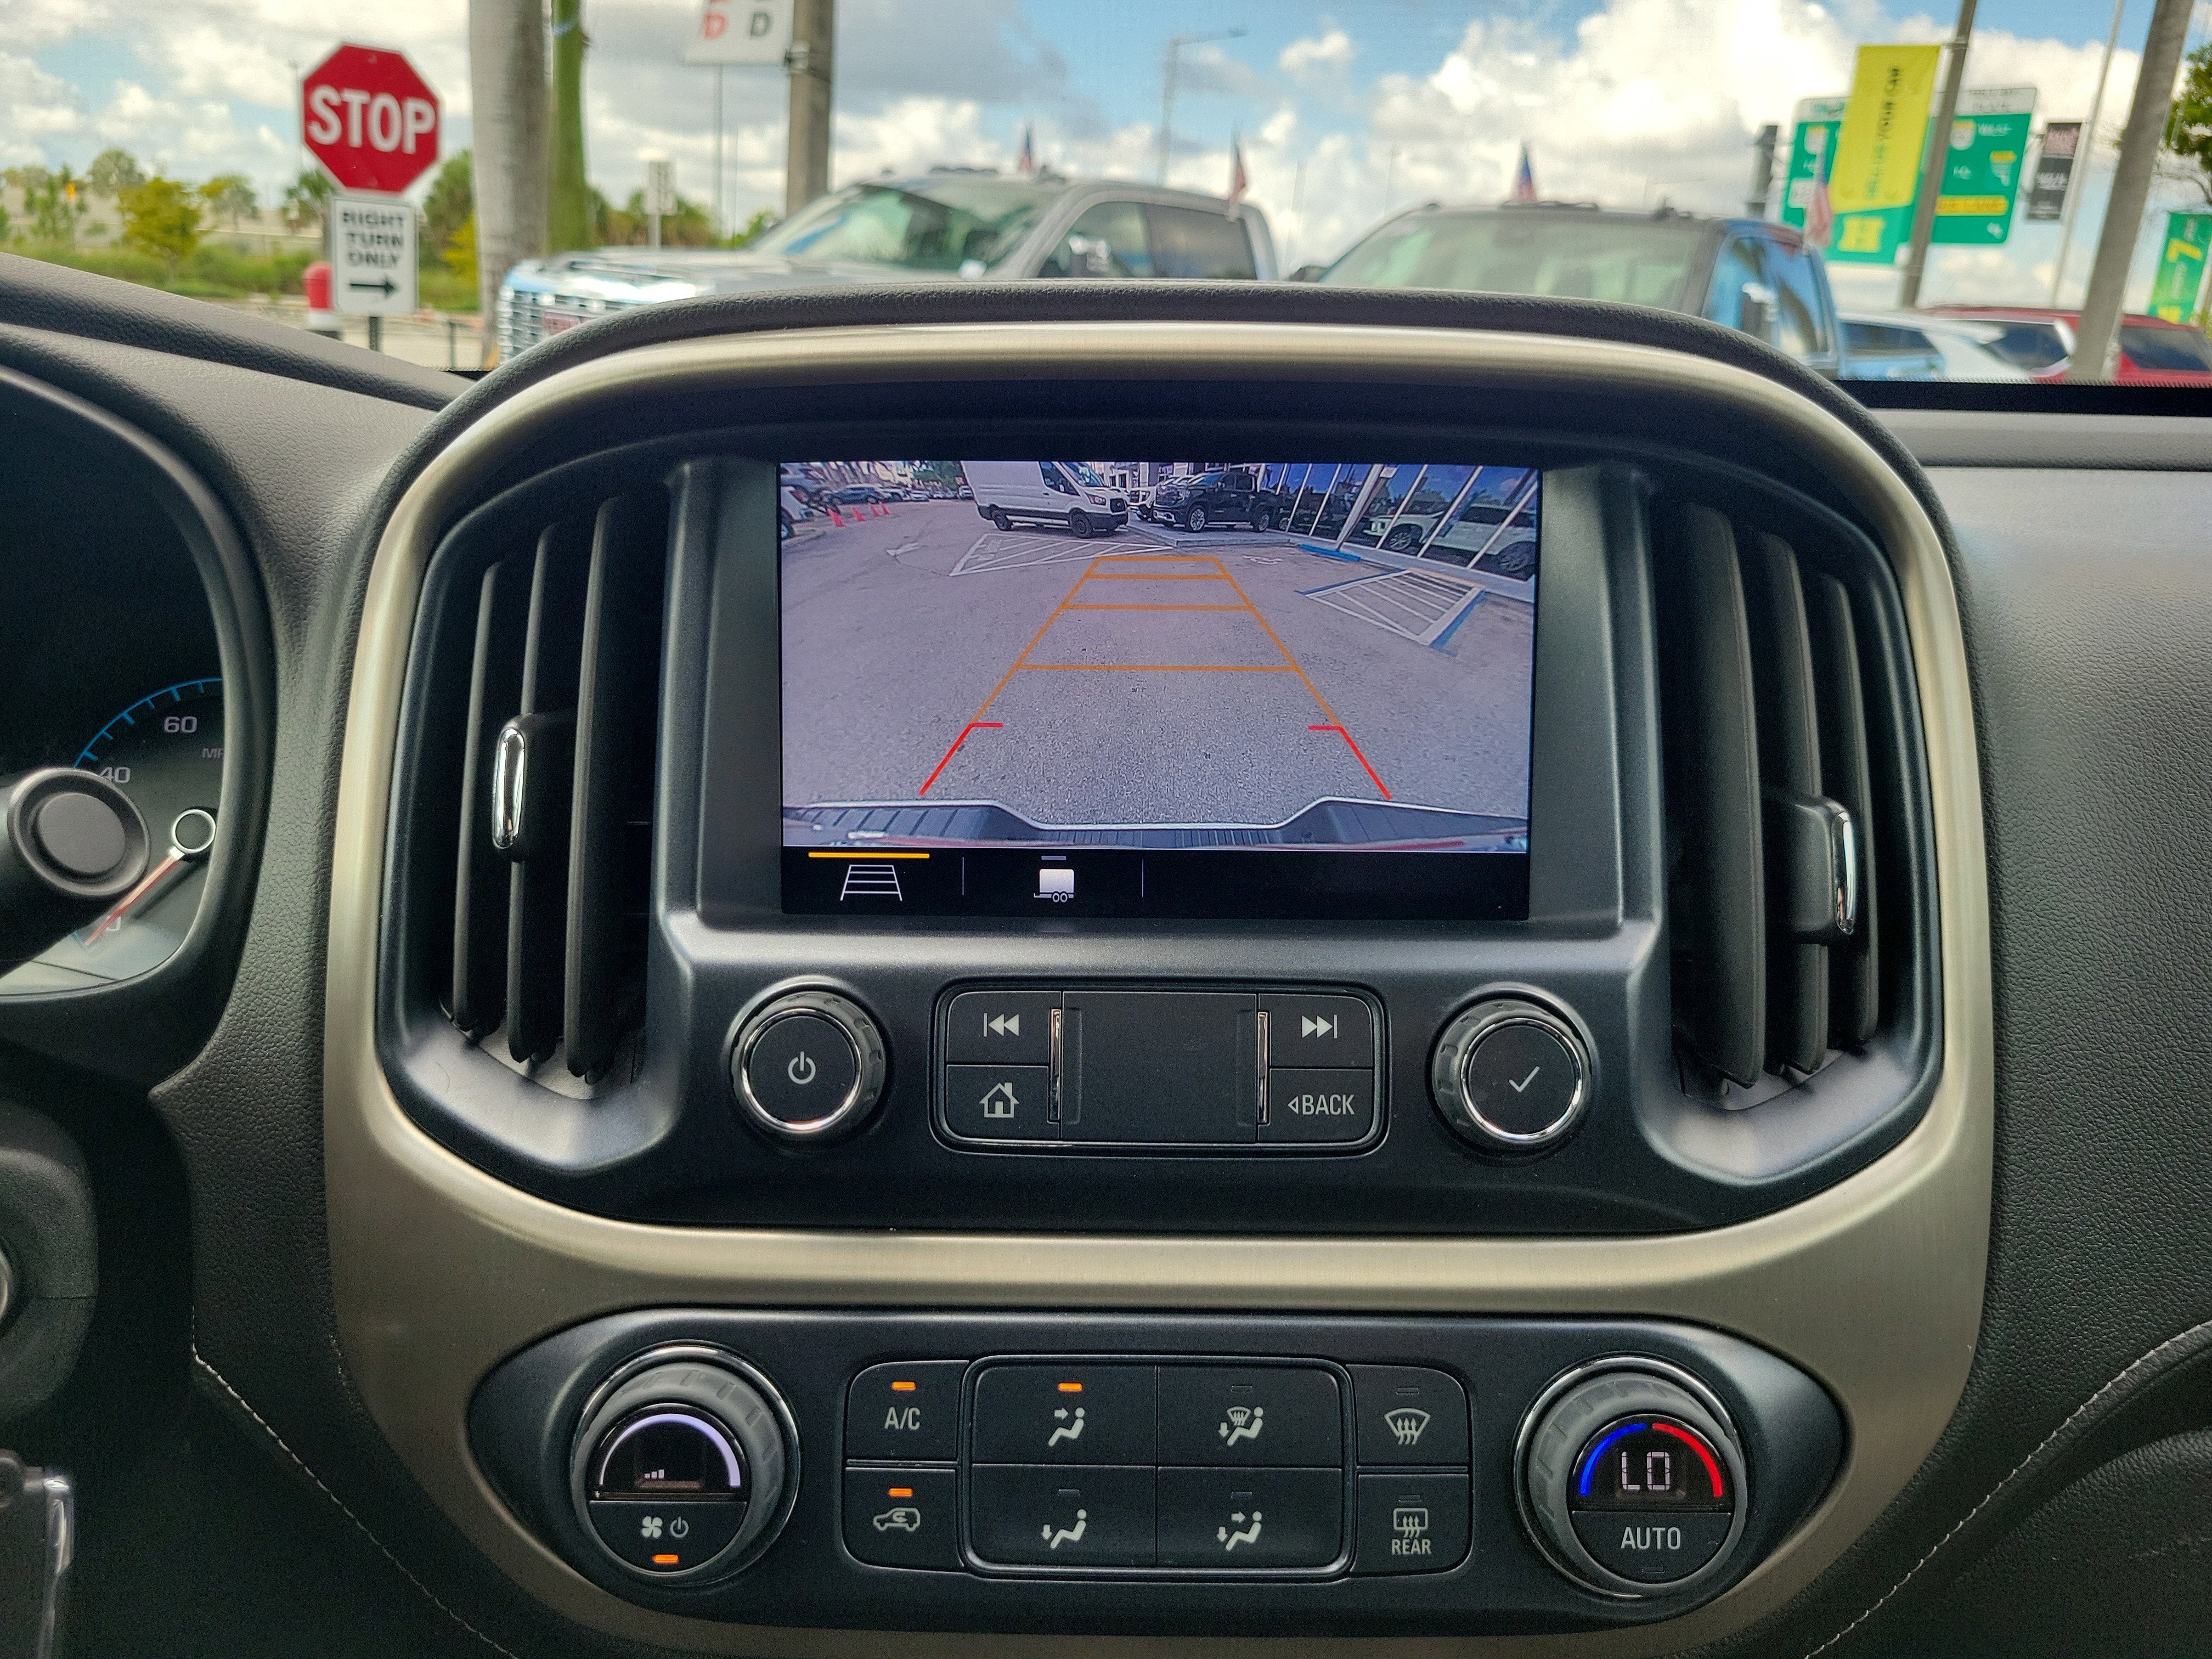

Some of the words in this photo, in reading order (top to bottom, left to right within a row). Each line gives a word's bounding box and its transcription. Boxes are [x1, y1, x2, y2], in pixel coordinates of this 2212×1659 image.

[308, 84, 436, 155] STOP
[342, 210, 404, 227] RIGHT
[346, 232, 404, 246] TURN
[348, 252, 400, 268] ONLY
[165, 716, 198, 733] 60
[100, 767, 131, 783] 40
[1302, 1094, 1355, 1115] BACK
[884, 1407, 921, 1431] A/C
[1621, 1451, 1671, 1491] LO
[1391, 1538, 1432, 1555] REAR
[1620, 1526, 1681, 1550] AUTO
